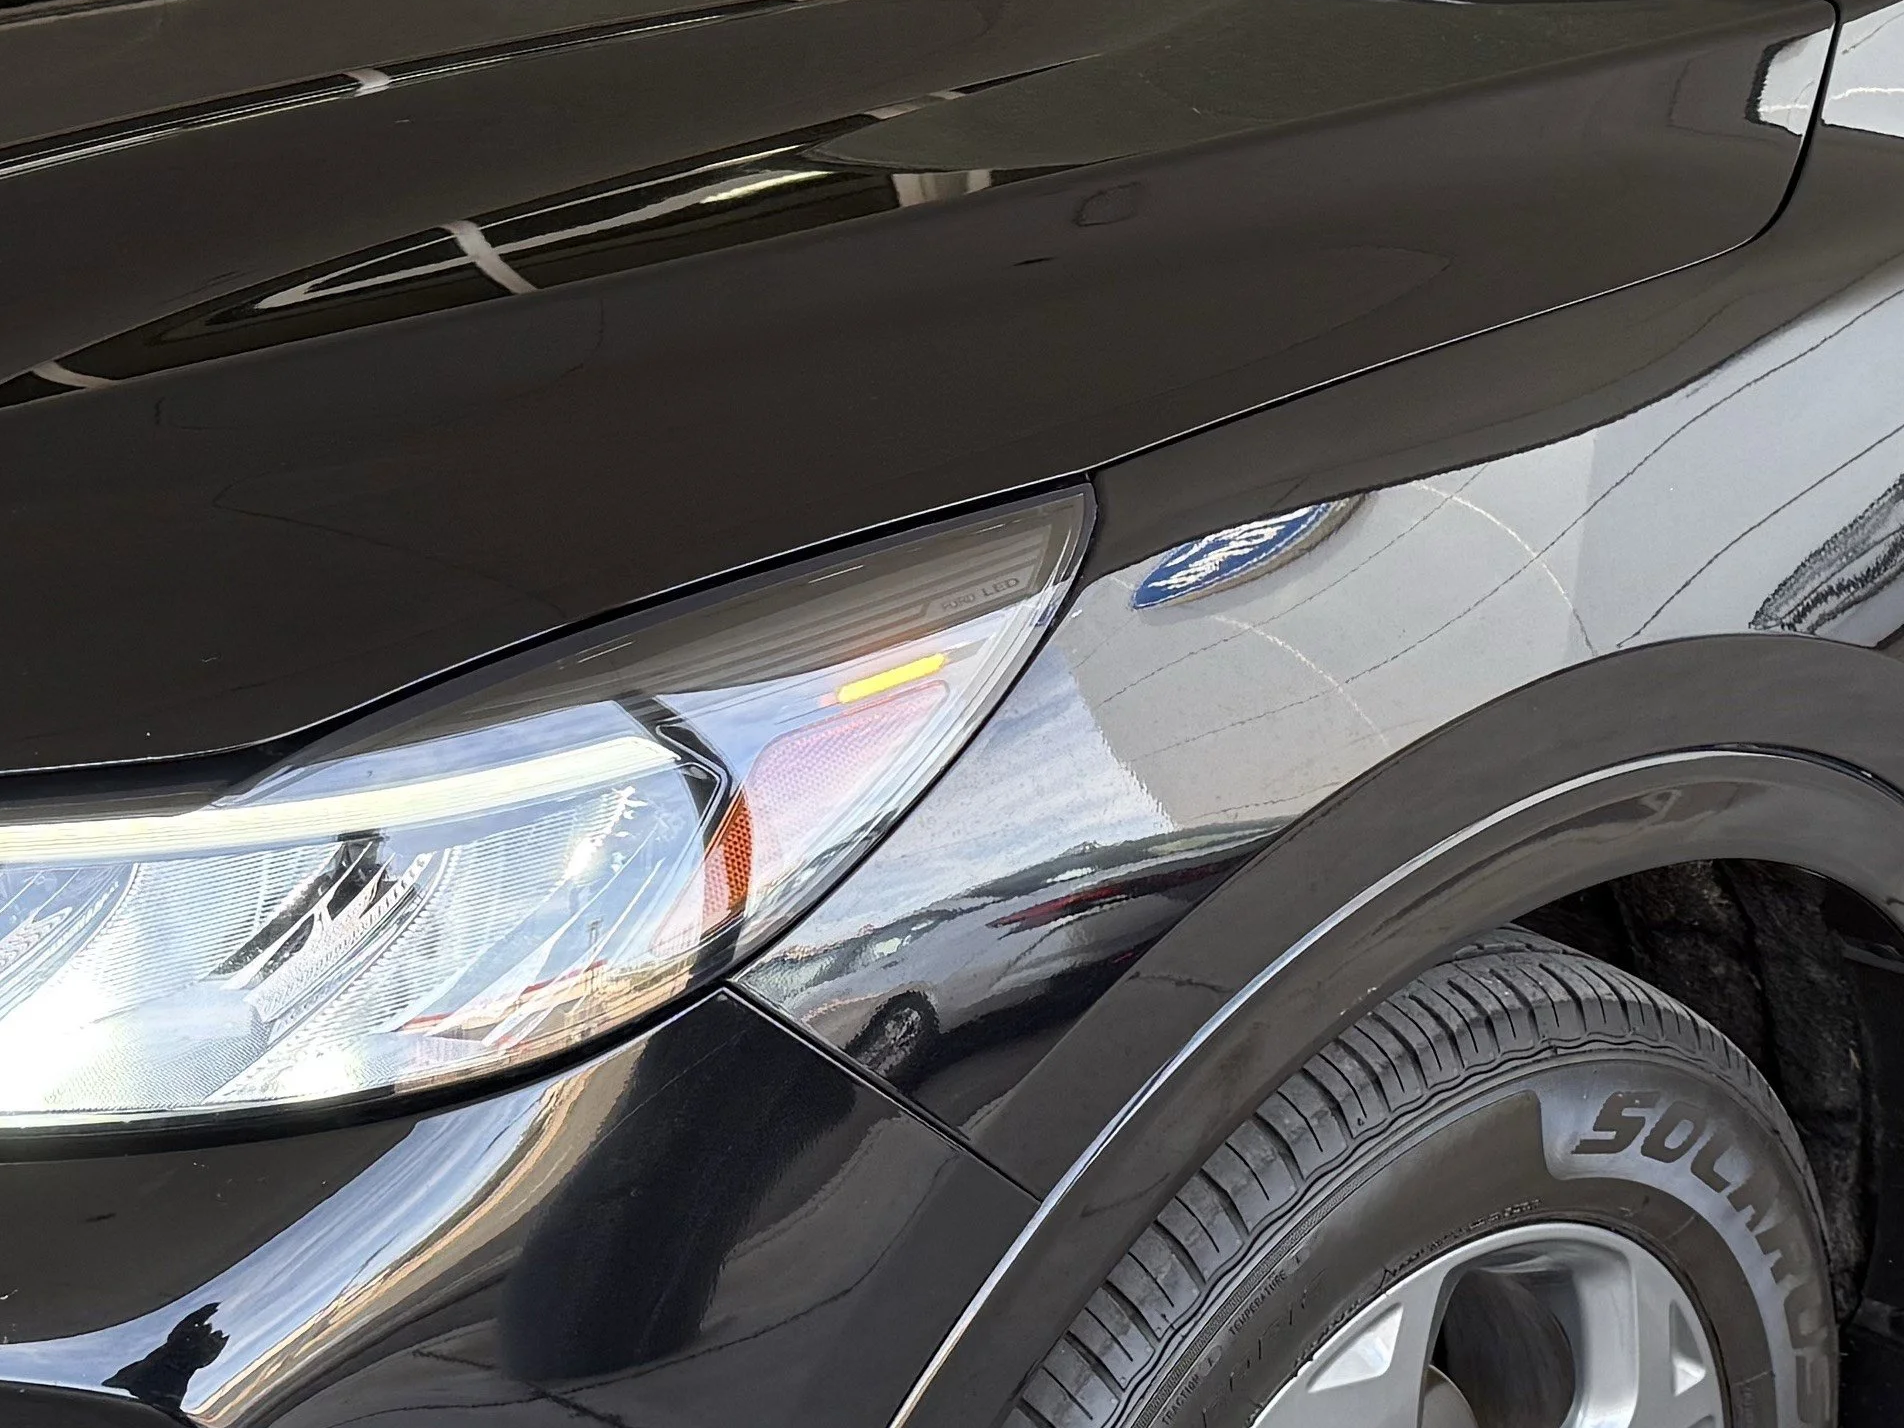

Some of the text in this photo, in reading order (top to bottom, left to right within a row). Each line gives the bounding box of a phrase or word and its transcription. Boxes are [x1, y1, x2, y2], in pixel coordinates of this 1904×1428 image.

[941, 577, 1021, 610] FORD LED
[1162, 1375, 1201, 1426] TRACTION
[1228, 1269, 1290, 1335] TEMPERATURE
